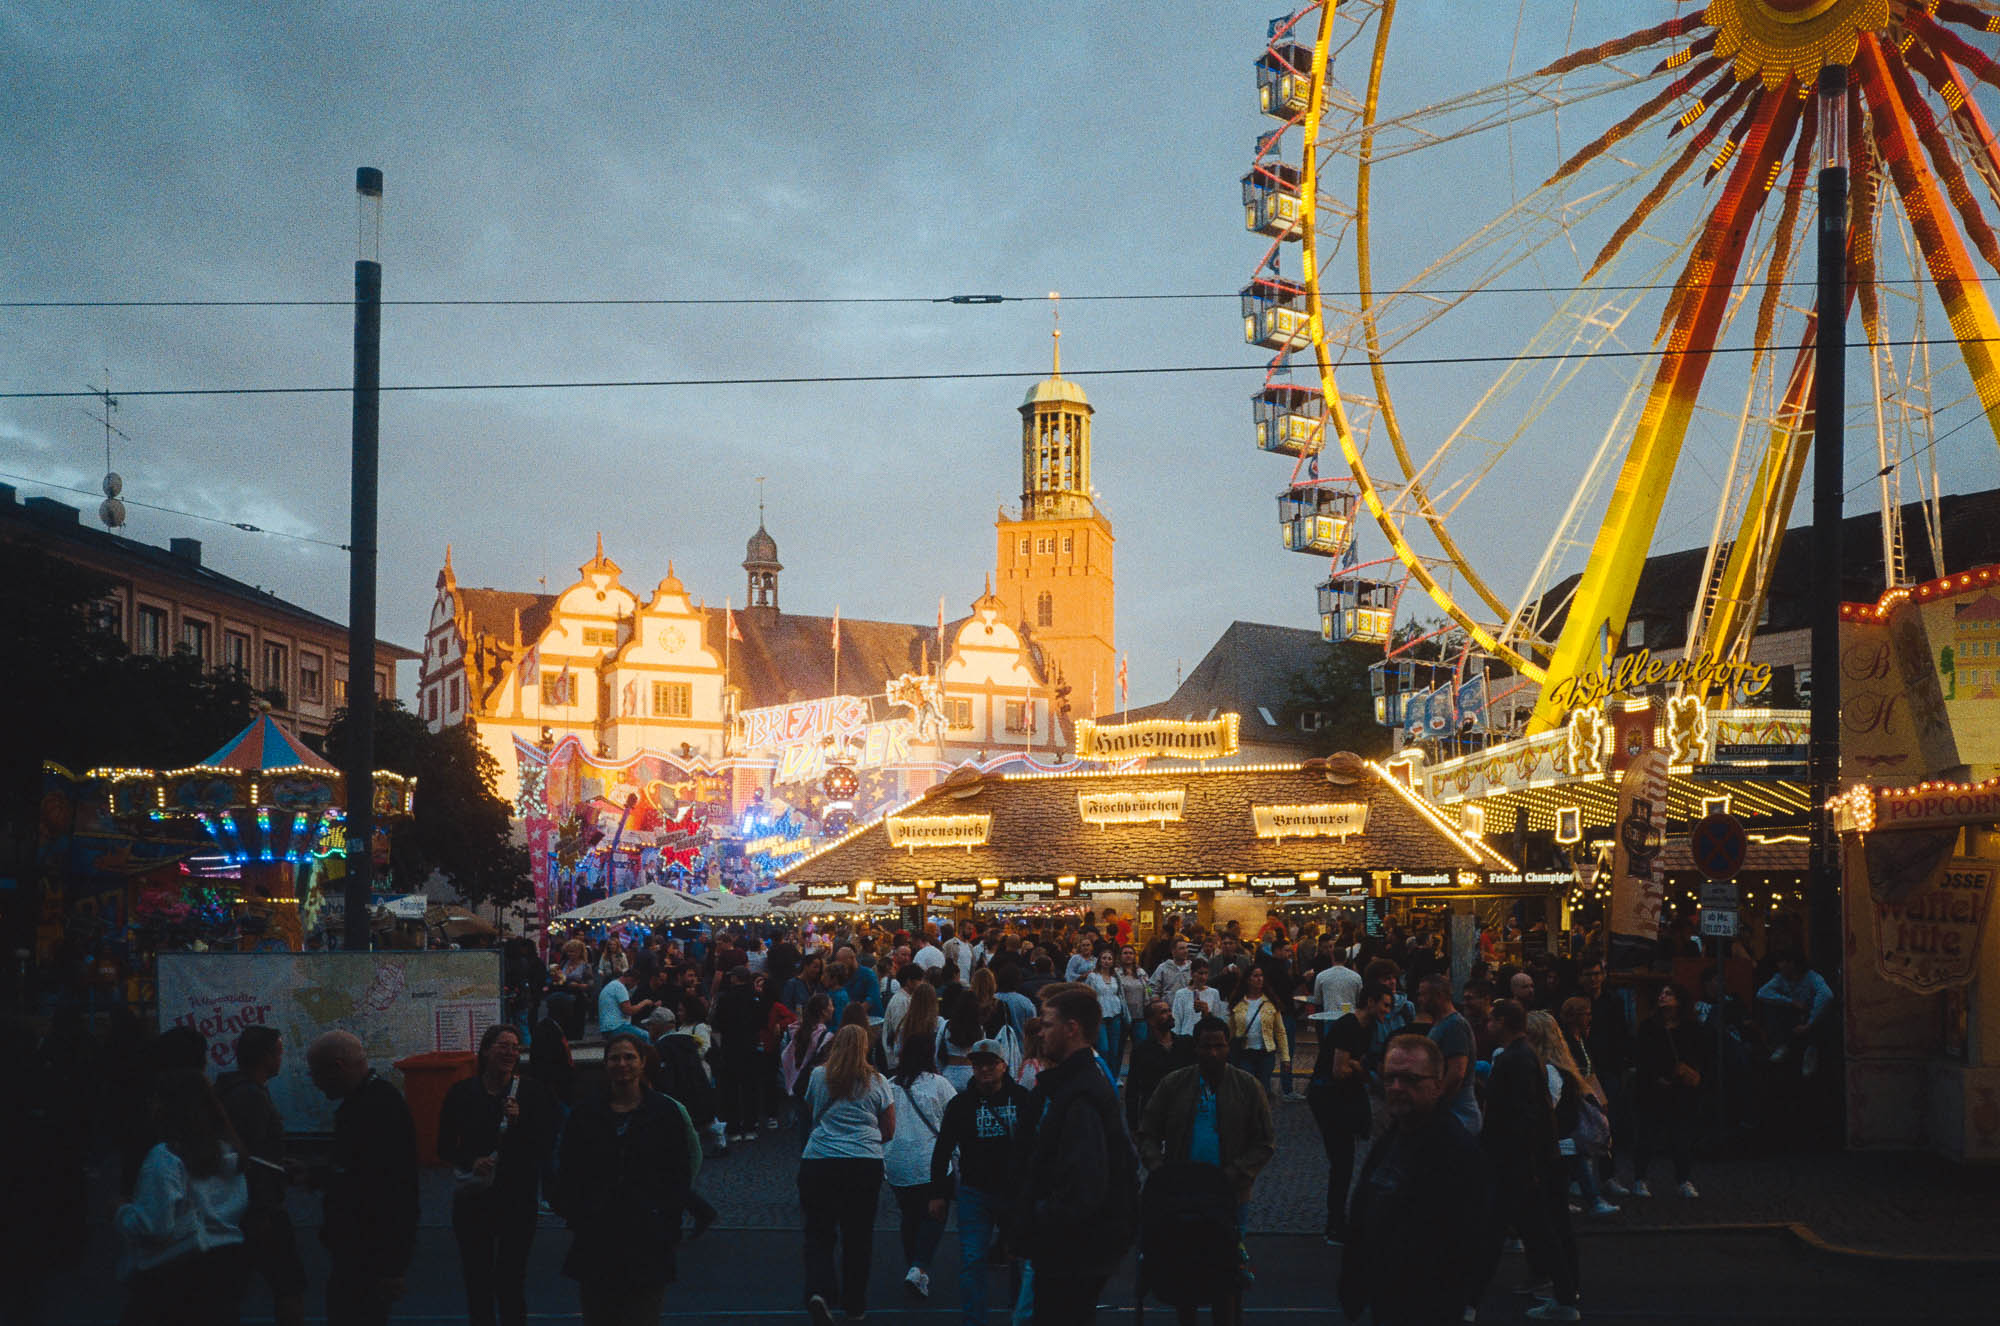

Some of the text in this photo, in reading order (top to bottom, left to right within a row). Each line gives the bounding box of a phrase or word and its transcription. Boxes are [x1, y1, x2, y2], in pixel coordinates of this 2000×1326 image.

[1549, 648, 1772, 708] Willenborg
[746, 699, 853, 750] BREAK
[1095, 731, 1217, 755] Hausmann
[1088, 800, 1179, 815] Fischbrötchen
[1890, 793, 2000, 819] POPCORN
[1272, 813, 1350, 827] Bratwurst
[898, 823, 983, 838] Nierenspieß
[1489, 872, 1522, 883] Frische
